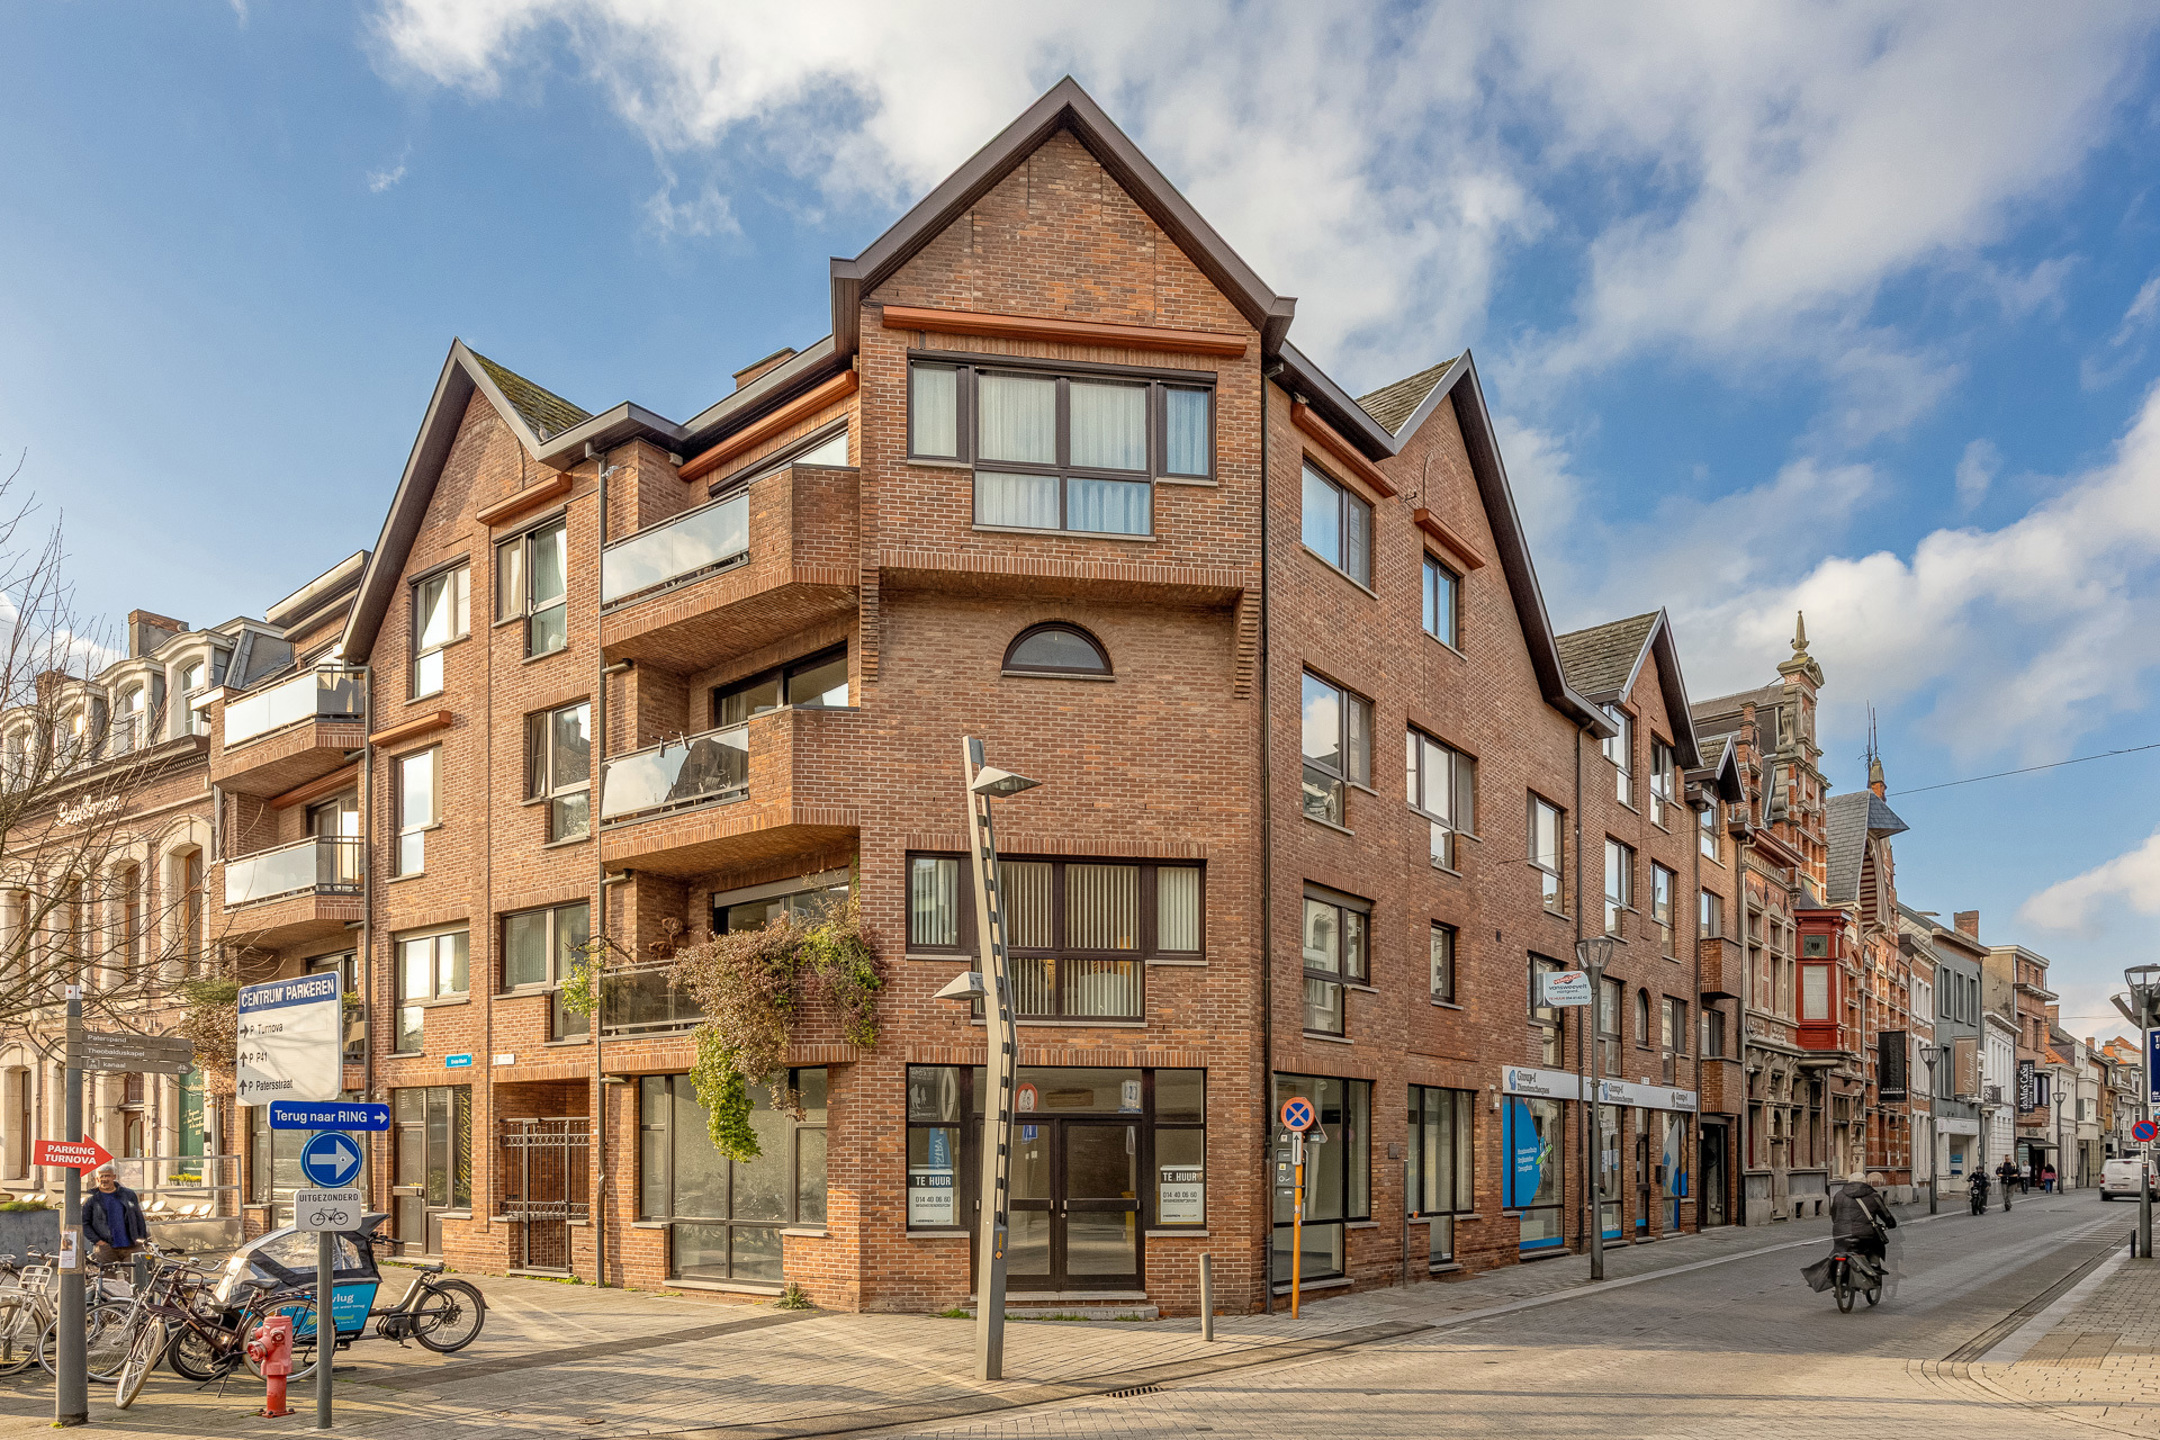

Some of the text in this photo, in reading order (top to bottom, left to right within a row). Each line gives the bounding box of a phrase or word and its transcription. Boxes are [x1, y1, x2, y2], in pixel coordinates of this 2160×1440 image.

[241, 978, 334, 1008] CENTRUM PARKEREN
[257, 1023, 283, 1034] Turnova
[87, 1035, 127, 1043] Paterspand
[88, 1047, 145, 1057] Theobalduskapel
[255, 1079, 293, 1092] Patersstraat
[274, 1110, 367, 1124] Terug naar RING
[47, 1144, 95, 1155] PARKING
[45, 1153, 97, 1165] TURNOVA
[916, 1176, 951, 1186] TE HUUR
[1162, 1172, 1197, 1181] TE HUUR
[299, 1193, 359, 1202] UITGEZONDERD
